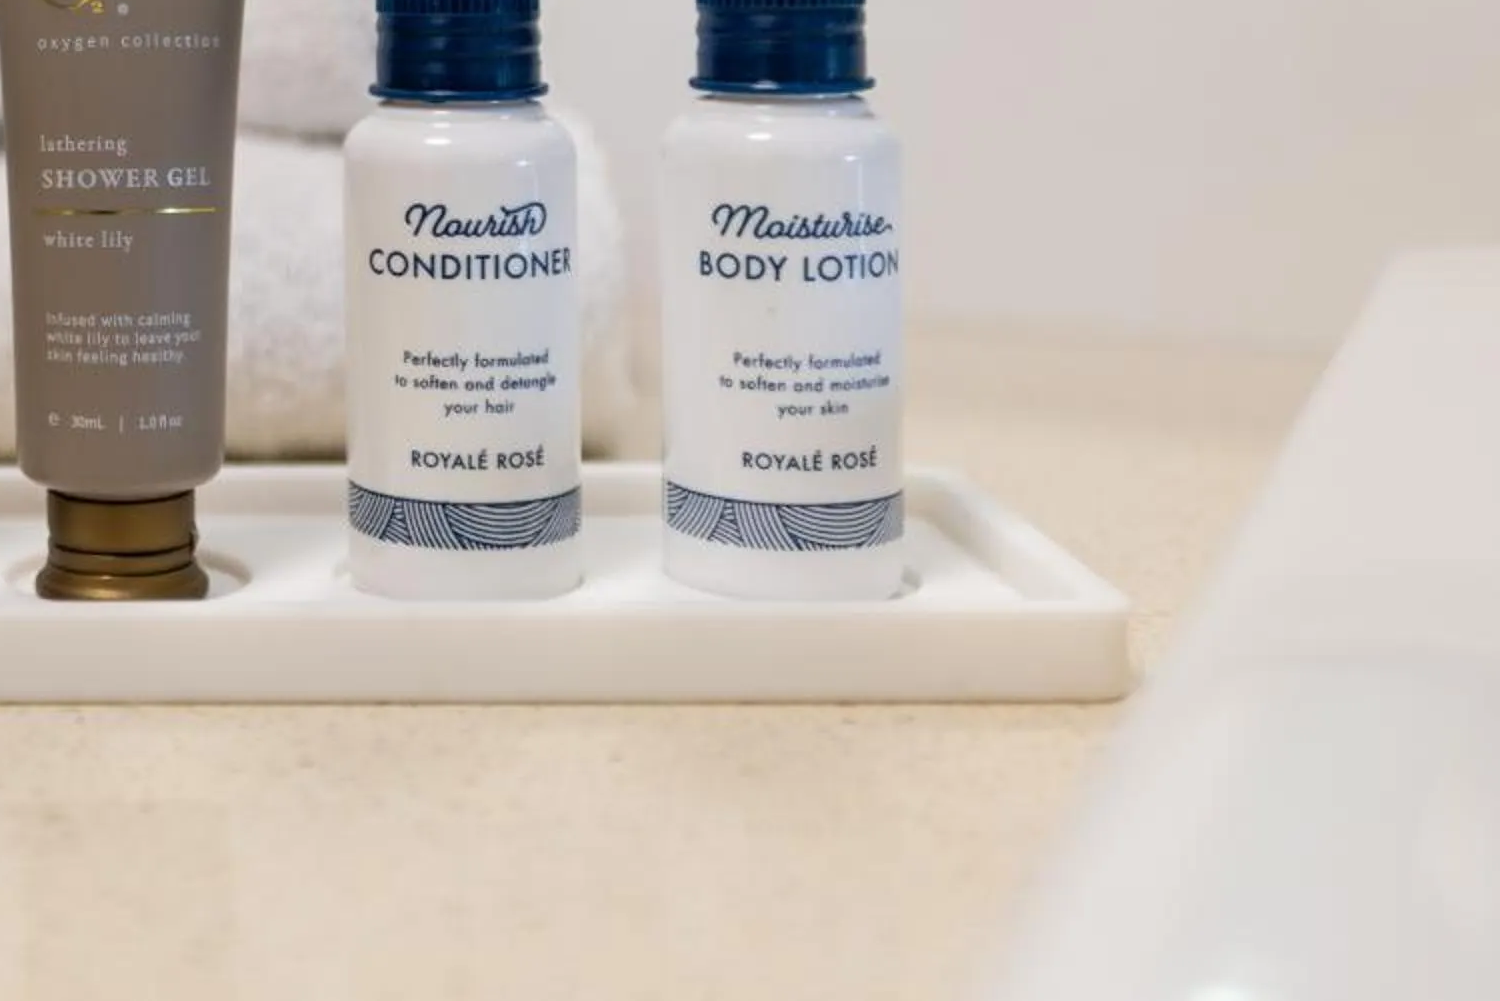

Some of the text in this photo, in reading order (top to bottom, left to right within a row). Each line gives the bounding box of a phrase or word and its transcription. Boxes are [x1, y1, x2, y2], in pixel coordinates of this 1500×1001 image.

[37, 32, 220, 52] oxygen collection
[40, 136, 128, 156] lathering
[41, 166, 211, 189] SHOWER GEL
[404, 202, 547, 238] Nourish
[712, 204, 893, 239] Moisturise
[44, 230, 134, 254] white lily
[369, 247, 571, 280] CONDITIONER
[699, 249, 899, 282] BODY LOTION
[101, 313, 133, 329] with
[138, 311, 192, 328] calming
[47, 331, 83, 346] white
[87, 330, 110, 348] lily
[115, 331, 130, 346] to
[135, 331, 171, 346] leave
[47, 349, 184, 366] skin feeling healthy
[403, 349, 549, 372] Perfectly formulated
[733, 350, 881, 372] Perfectly formulated
[395, 373, 556, 392] to soften and detangle
[719, 373, 890, 393] to soften and moisturise
[444, 399, 515, 418] your hair
[777, 400, 849, 419] your skin
[411, 445, 545, 471] ROYALÉ ROSÉ
[742, 445, 877, 472] ROYALÉ ROSÉ
